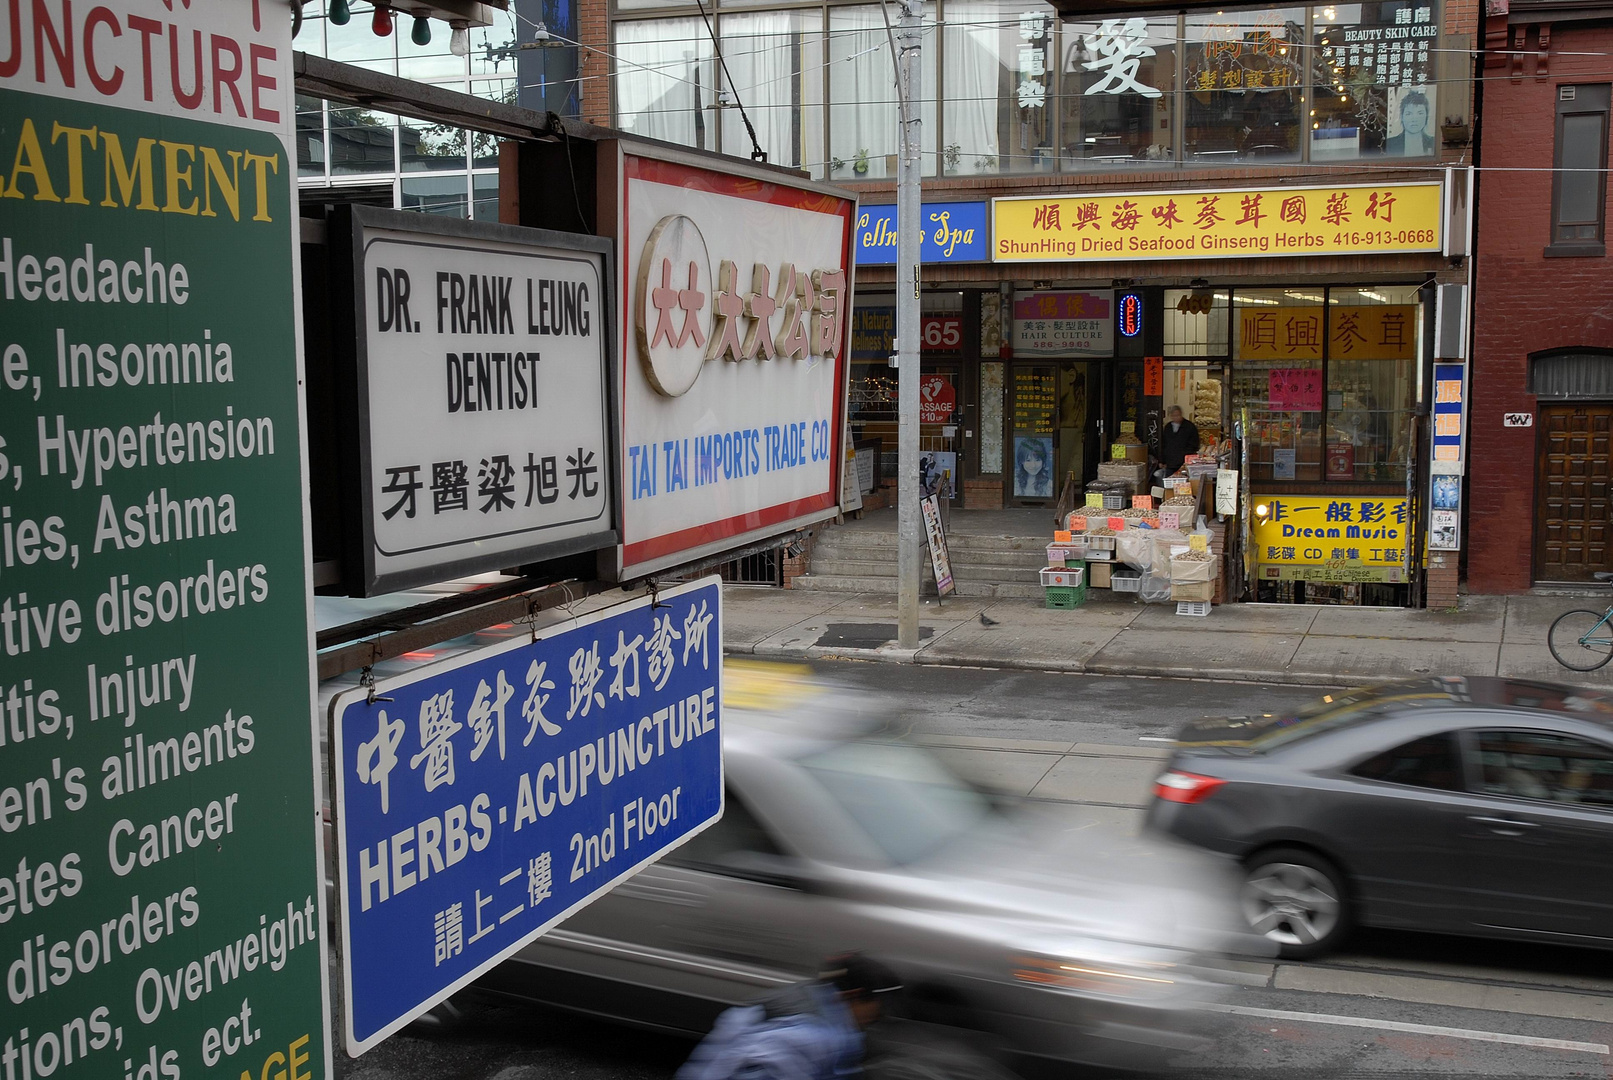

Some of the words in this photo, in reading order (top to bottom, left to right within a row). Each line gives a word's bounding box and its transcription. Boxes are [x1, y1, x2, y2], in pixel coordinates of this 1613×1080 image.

[1344, 29, 1383, 41] BEAUTY
[1385, 27, 1409, 39] SKIN
[1411, 25, 1437, 37] CARE
[0, 118, 279, 223] ATMENT
[930, 211, 975, 258] Spa
[1000, 239, 1076, 256] ShunHing
[1082, 237, 1124, 252] Dried
[1129, 235, 1196, 251] Seafood
[1201, 234, 1269, 251] Ginseng
[1275, 232, 1325, 248] Herbs
[1333, 229, 1435, 246] 416-913-0668
[375, 266, 421, 333] DR.
[435, 271, 515, 335] FRANK
[526, 277, 591, 337] LEUNG
[862, 310, 893, 330] Natural
[920, 321, 961, 346] 65
[1126, 297, 1135, 334] OPEN
[1177, 294, 1214, 315] 469
[56, 329, 234, 388] Insomnia
[883, 331, 896, 355] Sp
[1021, 332, 1047, 340] HAIR
[1054, 331, 1103, 340] CULTURE
[446, 352, 541, 413] DENTIST
[919, 403, 952, 412] ASSAGE
[37, 406, 275, 490] Hypertension
[920, 413, 936, 423] $10
[381, 447, 599, 521] 牙醫梁旭光
[629, 445, 658, 500] TAI
[664, 439, 689, 493] TAI
[694, 429, 761, 488] IMPORTS
[764, 421, 807, 473] TRADE
[811, 419, 830, 463] CO.
[2, 506, 80, 569] ies,
[93, 487, 238, 553] Asthma
[1282, 524, 1340, 538] Dream
[1346, 525, 1398, 539] Music
[1303, 548, 1323, 559] CD
[1, 592, 83, 656] tive
[96, 559, 269, 635] disorders
[88, 654, 197, 728] Injury
[355, 598, 714, 815] 中醫針灸跌打診所
[0, 757, 88, 833] en's
[101, 708, 255, 800] ailments
[359, 792, 494, 913] HERBS
[513, 686, 716, 831] ACUPUNCTURE
[0, 852, 83, 923] etes
[108, 793, 239, 877] Cancer
[434, 851, 552, 968] 請上二樓
[569, 814, 617, 884] 2nd
[623, 786, 682, 850] Floor
[7, 886, 200, 1004] disorders
[2, 1005, 123, 1080] tions,
[136, 895, 316, 1024] Overweight
[202, 997, 262, 1068] ect.
[240, 1033, 312, 1080] GE
